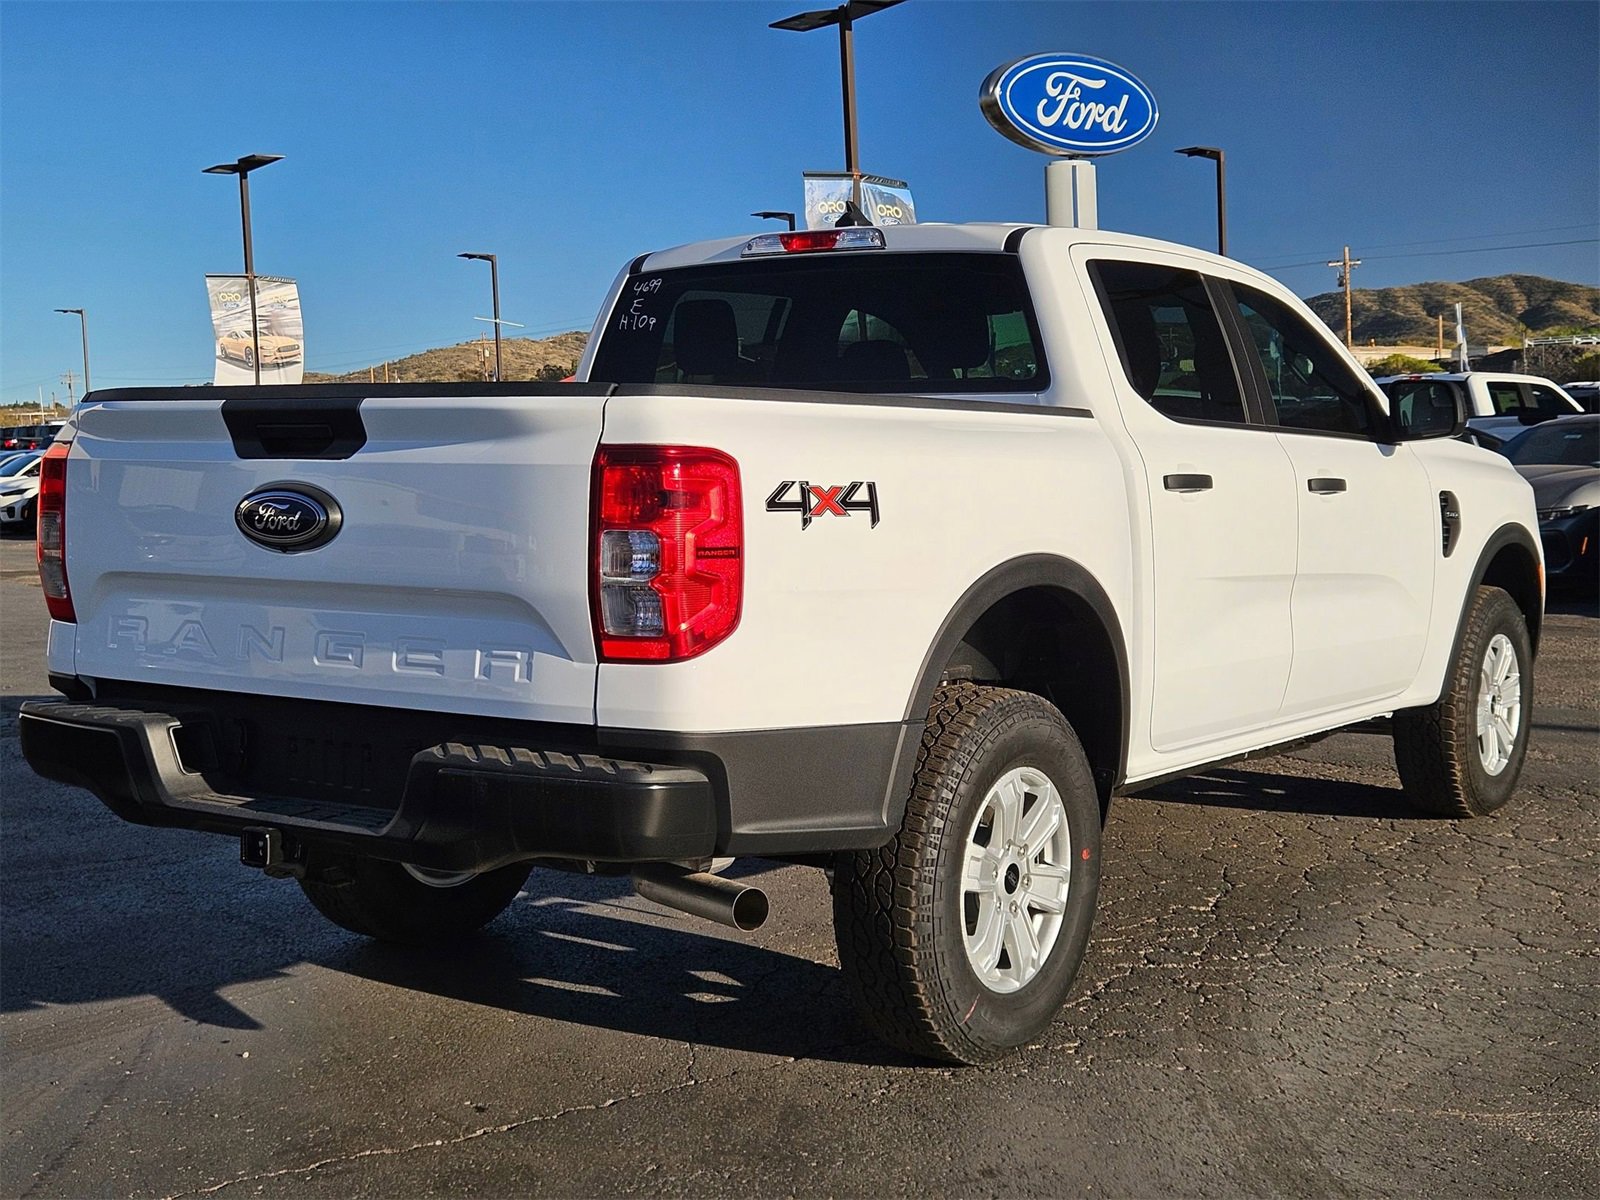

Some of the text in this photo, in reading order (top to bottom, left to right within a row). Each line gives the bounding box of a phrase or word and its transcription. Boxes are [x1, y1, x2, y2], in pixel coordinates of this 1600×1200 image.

[1036, 71, 1130, 134] Ford
[818, 200, 847, 214] ORO
[877, 204, 903, 219] ORO
[633, 278, 663, 296] 4699
[630, 298, 645, 315] E
[254, 502, 302, 531] Ford
[107, 614, 535, 683] RANGER
